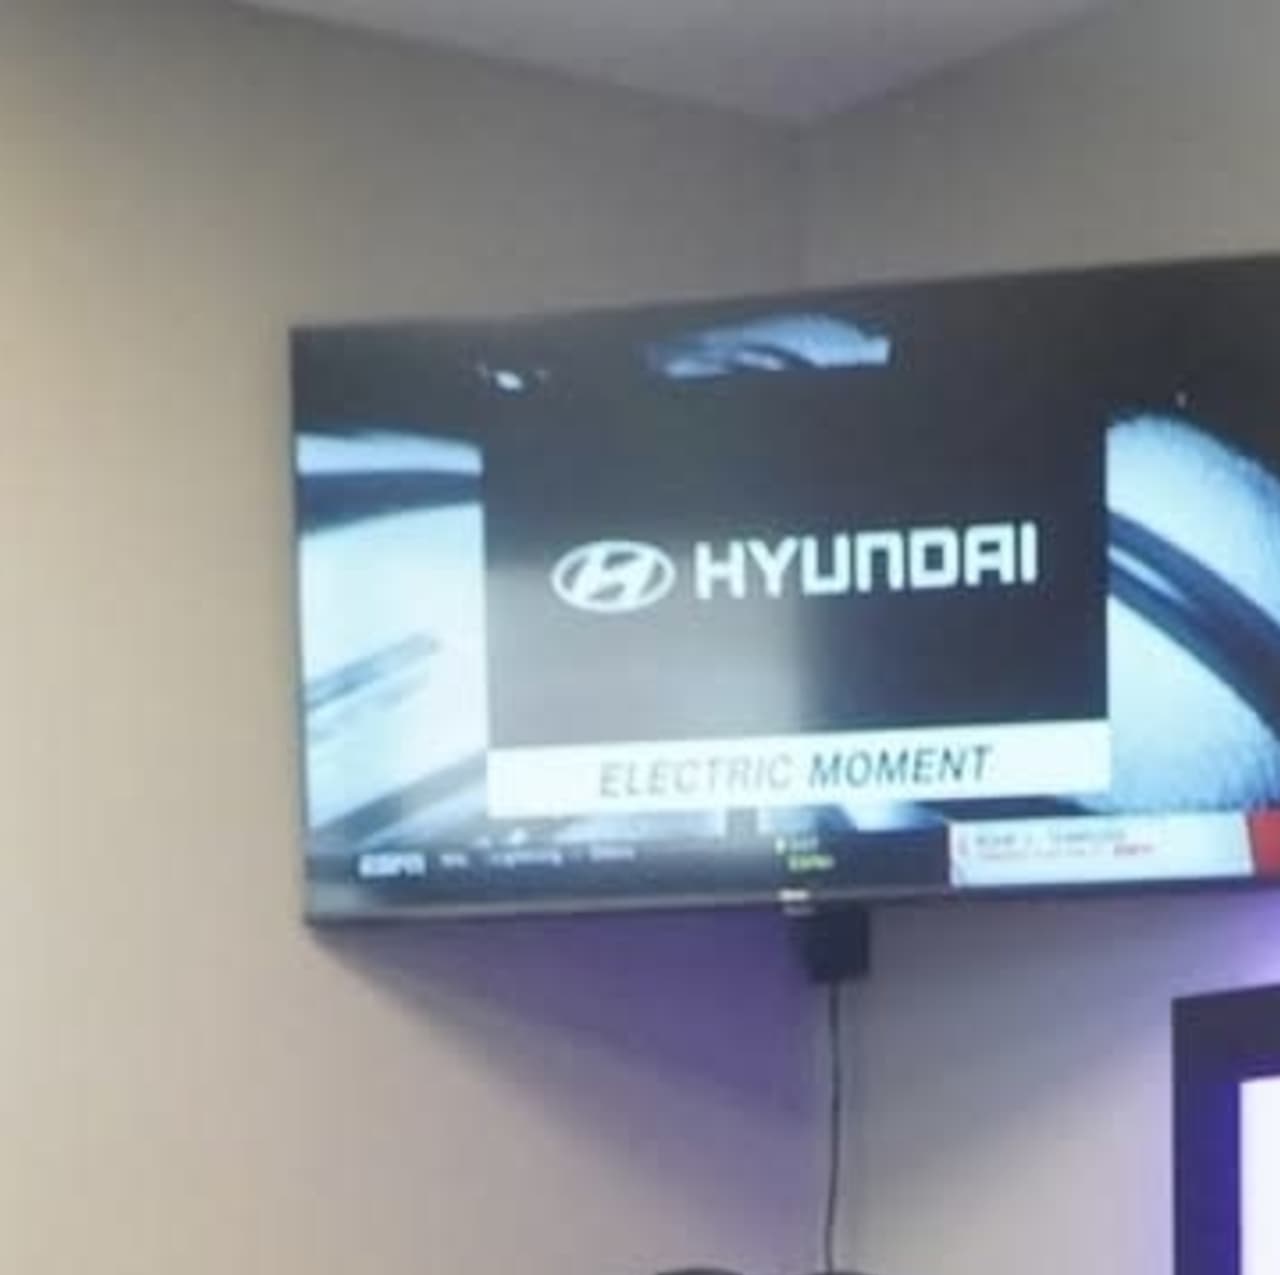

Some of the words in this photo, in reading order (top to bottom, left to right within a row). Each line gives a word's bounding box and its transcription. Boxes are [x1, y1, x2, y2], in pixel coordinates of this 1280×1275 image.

[693, 521, 1038, 600] HYUNDAI
[598, 751, 794, 799] ELECTRIC
[807, 743, 993, 790] MOMENT
